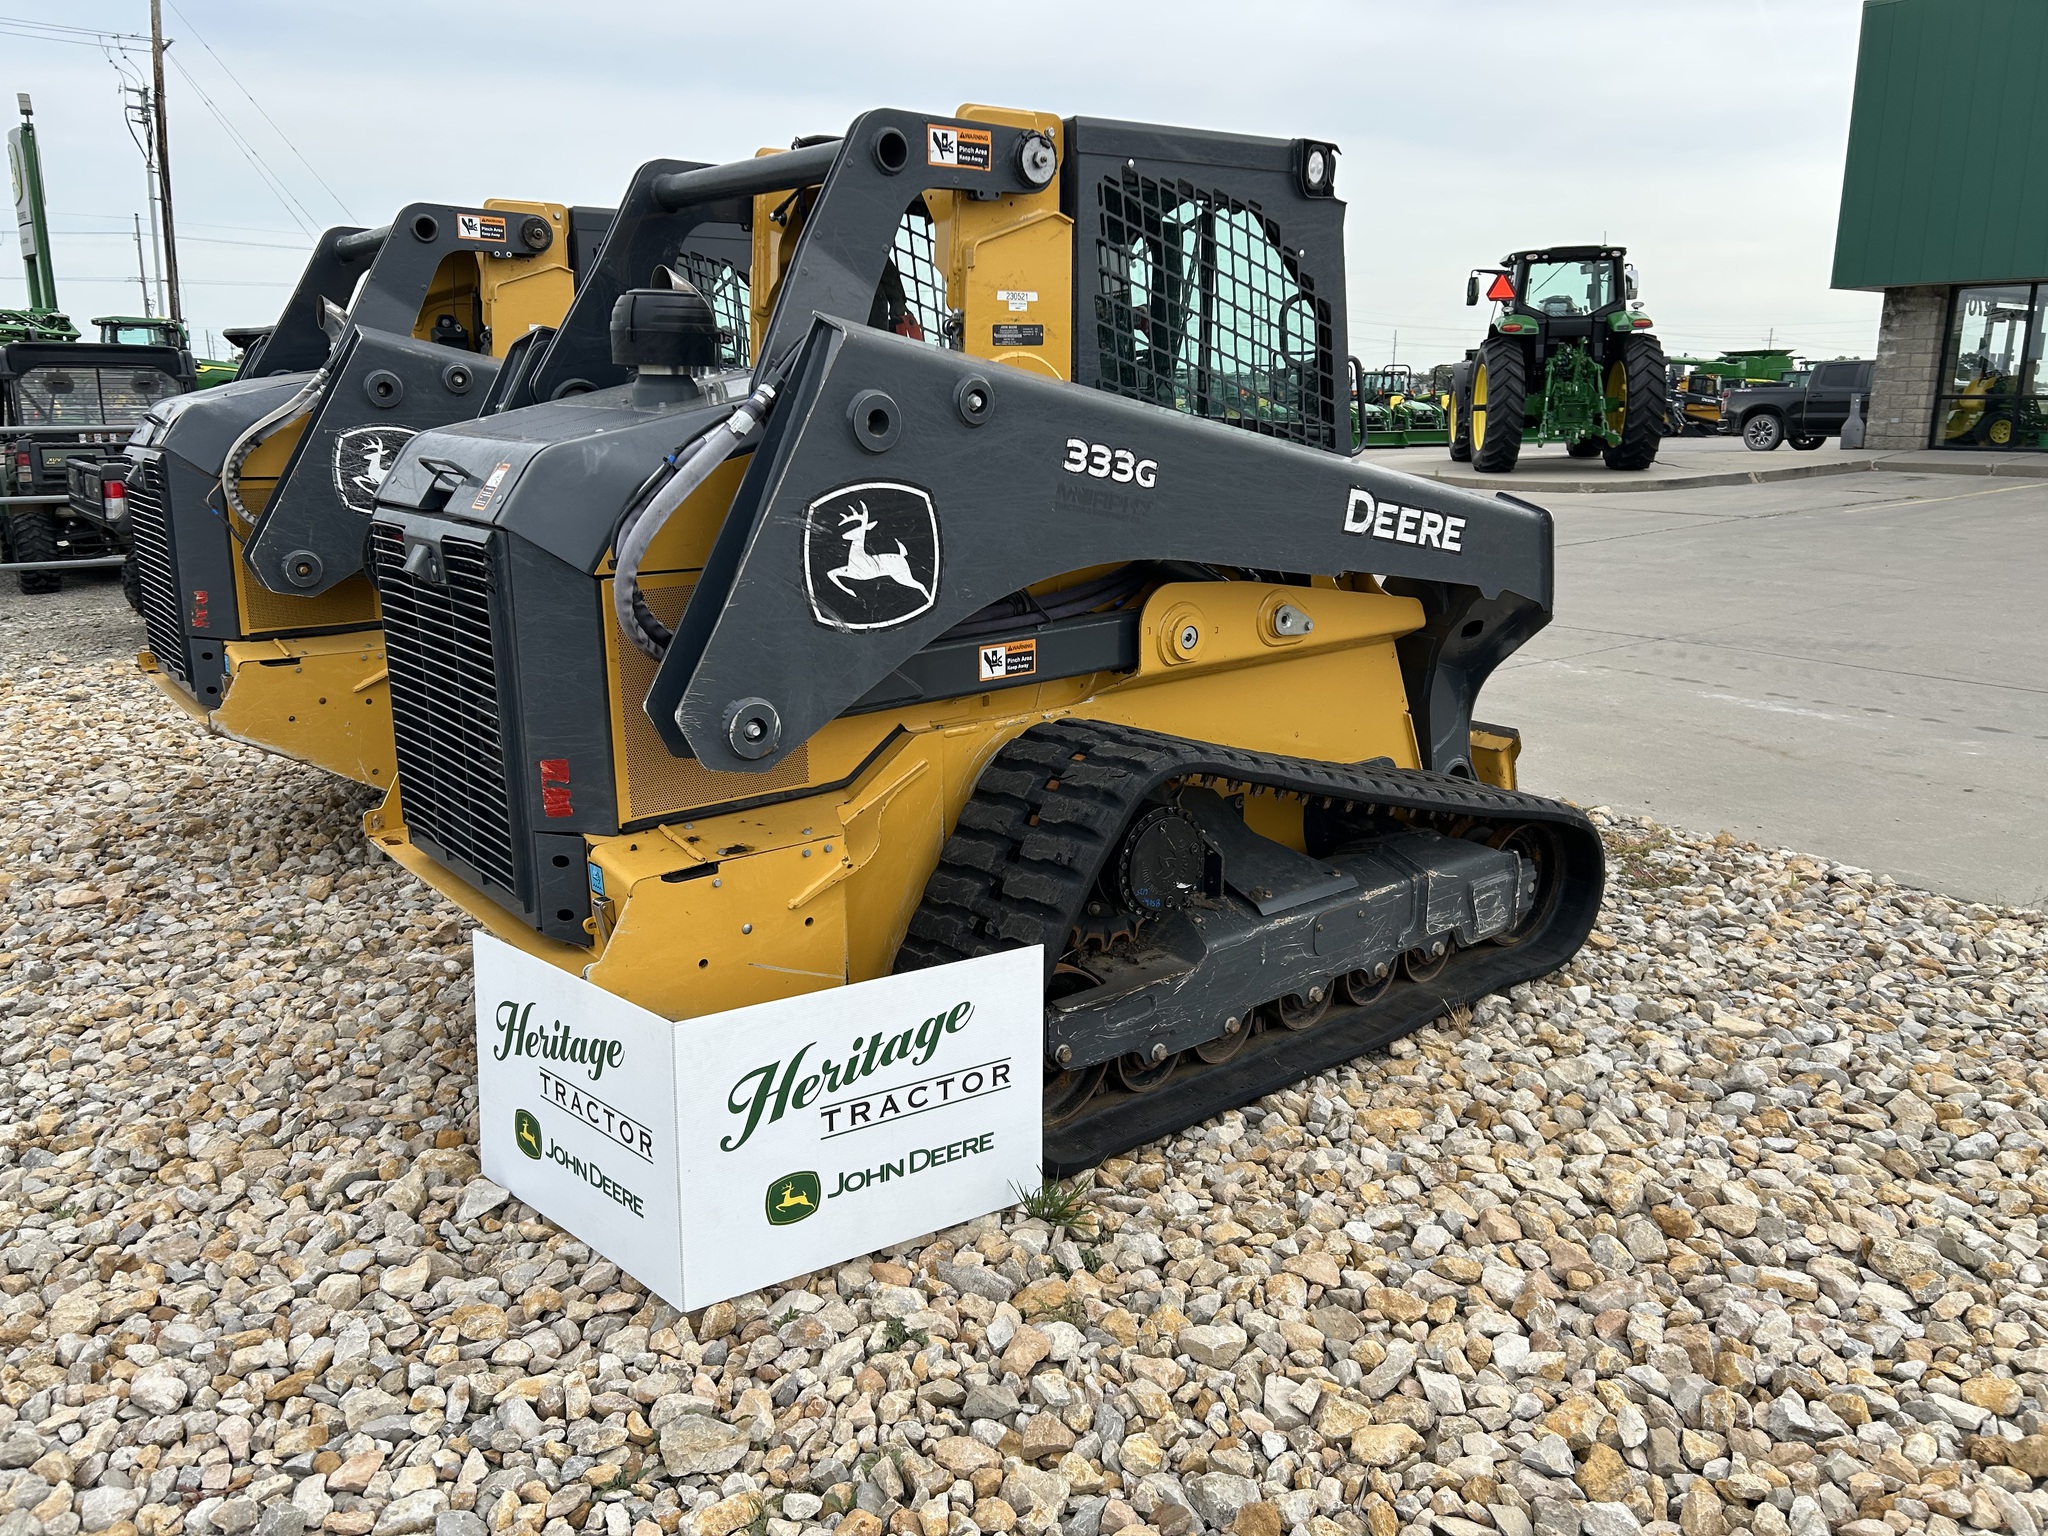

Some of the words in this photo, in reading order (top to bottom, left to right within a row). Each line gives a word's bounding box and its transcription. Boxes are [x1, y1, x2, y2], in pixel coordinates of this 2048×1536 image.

[959, 145, 974, 153] Pinch
[975, 147, 987, 155] Area
[964, 132, 988, 141] WARNING
[1006, 292, 1029, 301] 230521
[1063, 438, 1158, 488] 333G
[1343, 488, 1466, 552] DEERE
[493, 1000, 626, 1081] Heritage
[720, 1001, 975, 1152] Heritage
[820, 1063, 1011, 1132] TRACTOR
[539, 1071, 653, 1158] TRACTOR
[545, 1137, 588, 1182] JOHN
[589, 1161, 644, 1219] DEERE
[828, 1158, 905, 1199] JOHN
[909, 1131, 995, 1175] DEERE
